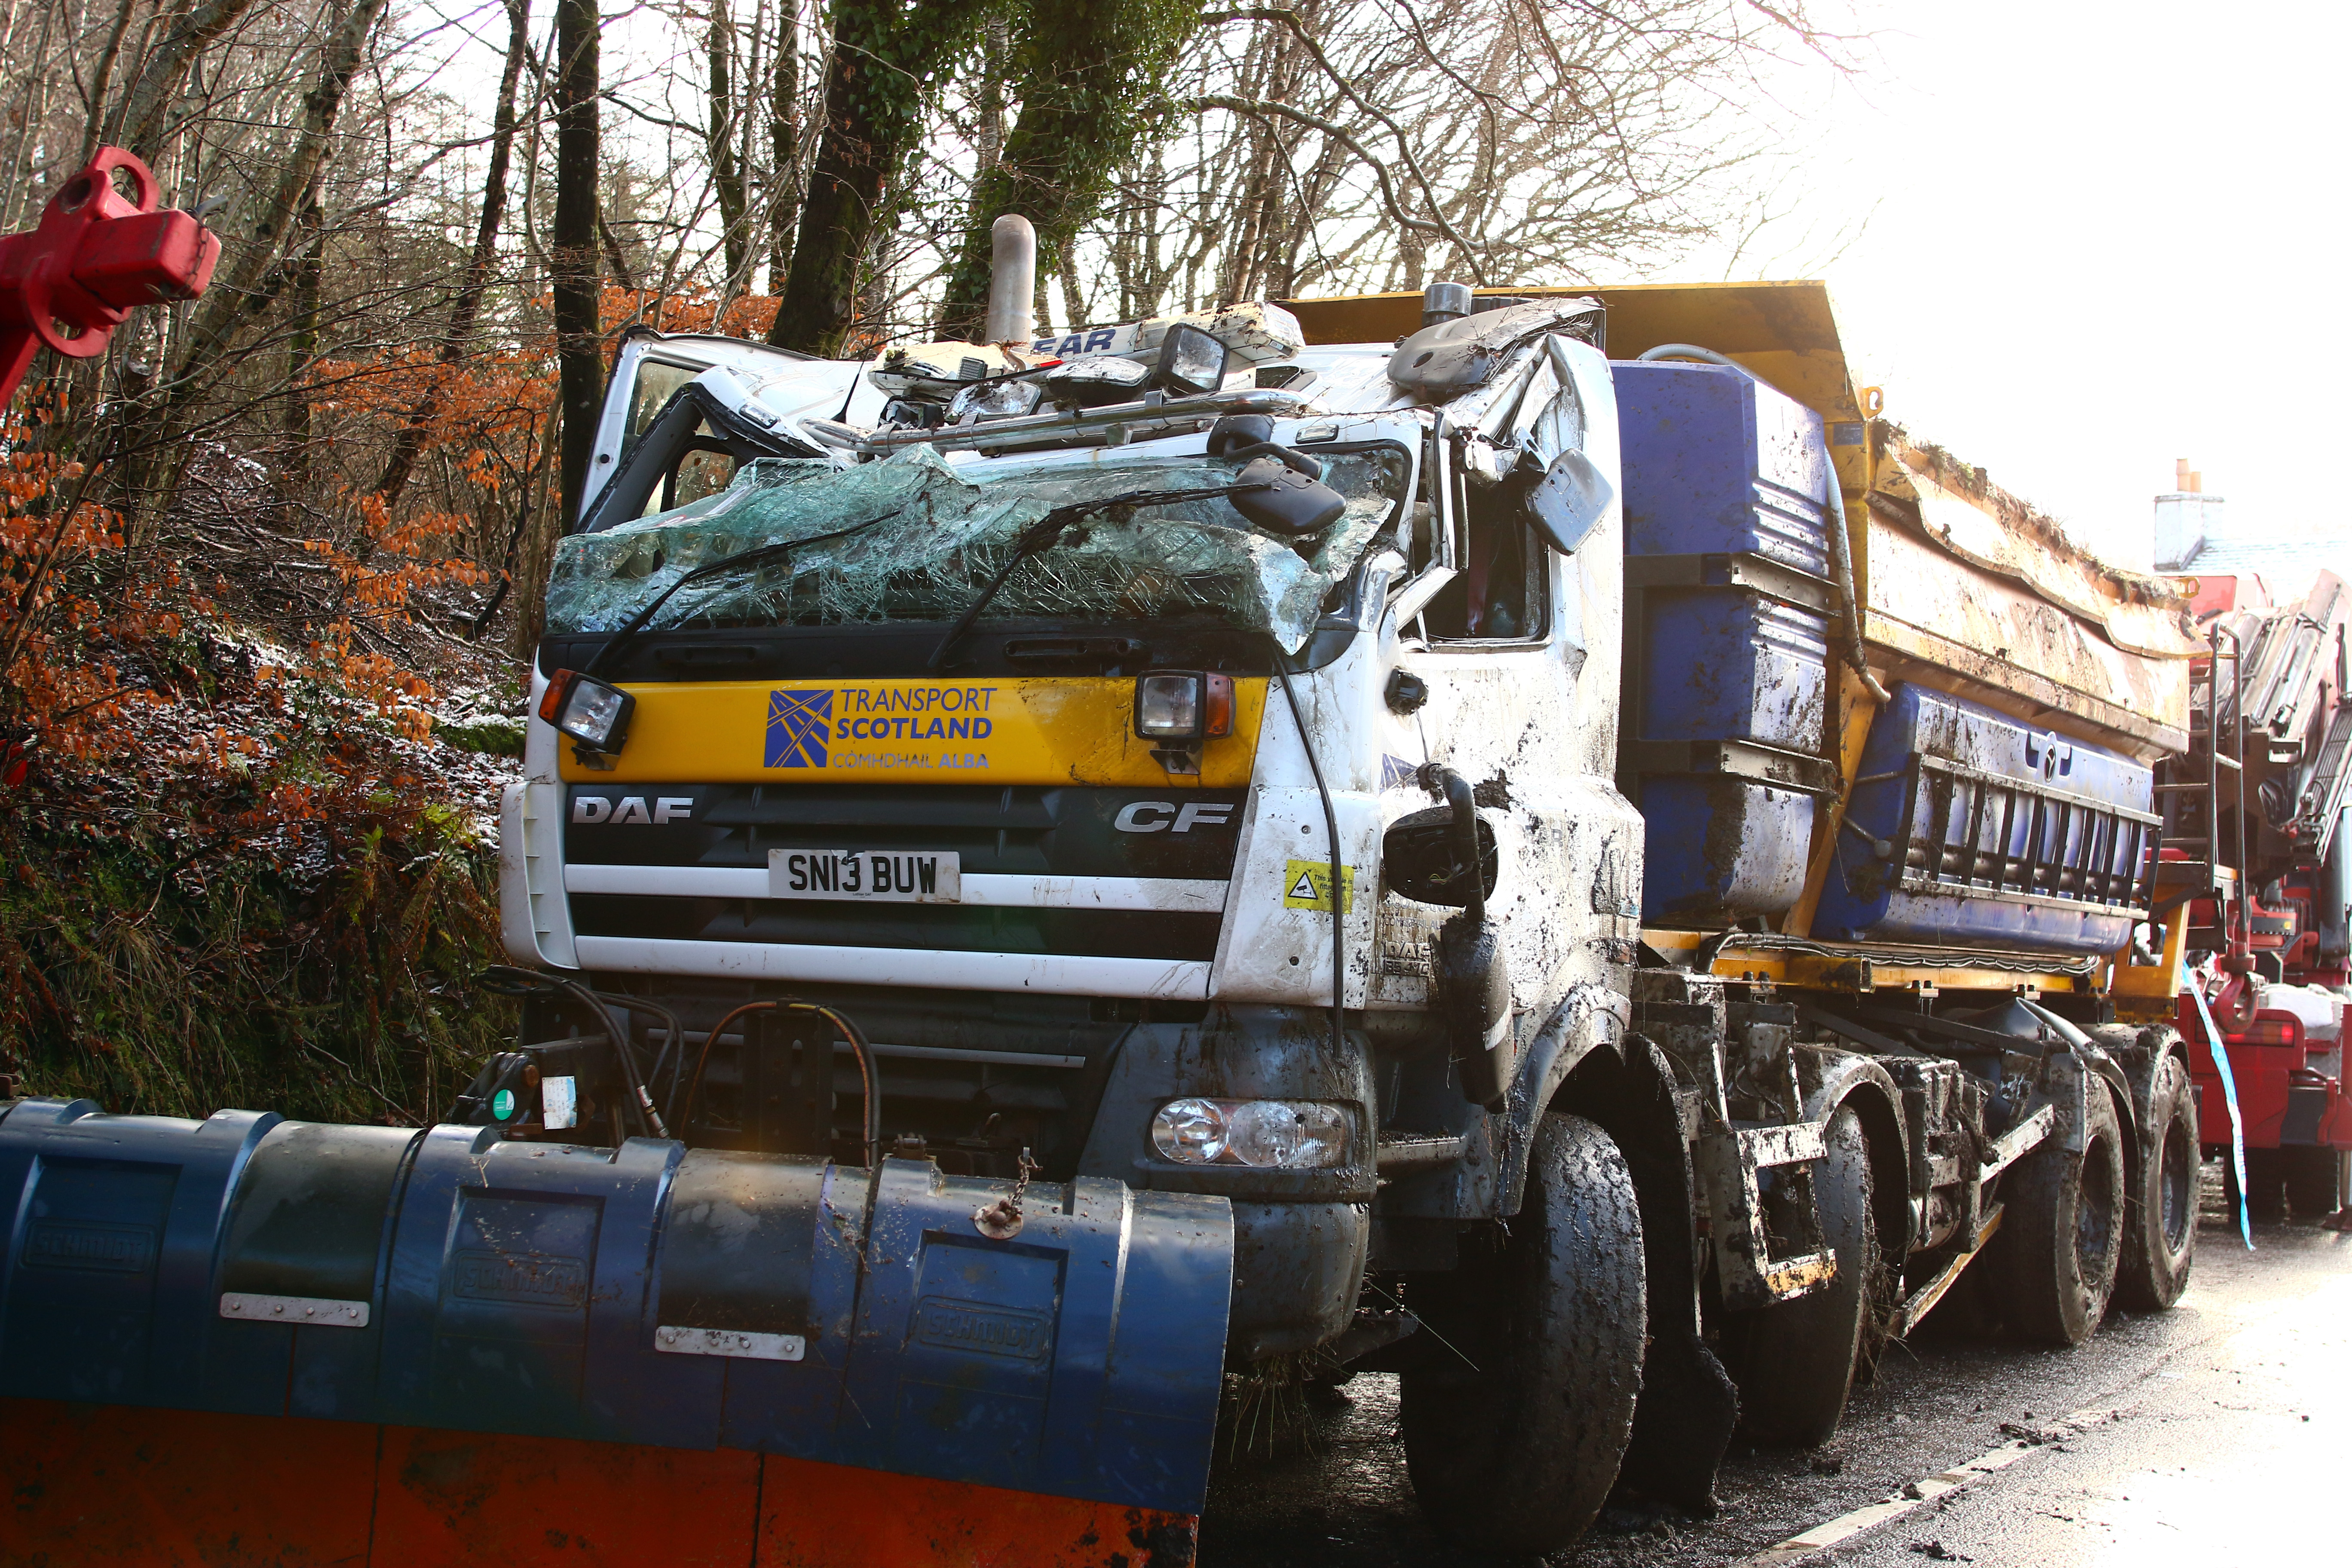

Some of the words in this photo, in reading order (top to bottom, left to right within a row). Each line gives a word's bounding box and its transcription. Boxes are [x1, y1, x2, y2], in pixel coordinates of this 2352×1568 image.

[1033, 329, 1116, 358] EAR
[840, 688, 998, 712] TRANSPORT
[836, 717, 992, 739] SCOTLAND
[937, 753, 989, 768] ALBA
[572, 796, 694, 824] DAF
[1114, 801, 1234, 833] CF
[788, 854, 861, 891] SN13
[871, 856, 937, 894] BUW
[929, 1313, 1037, 1349] SCHMIDT
